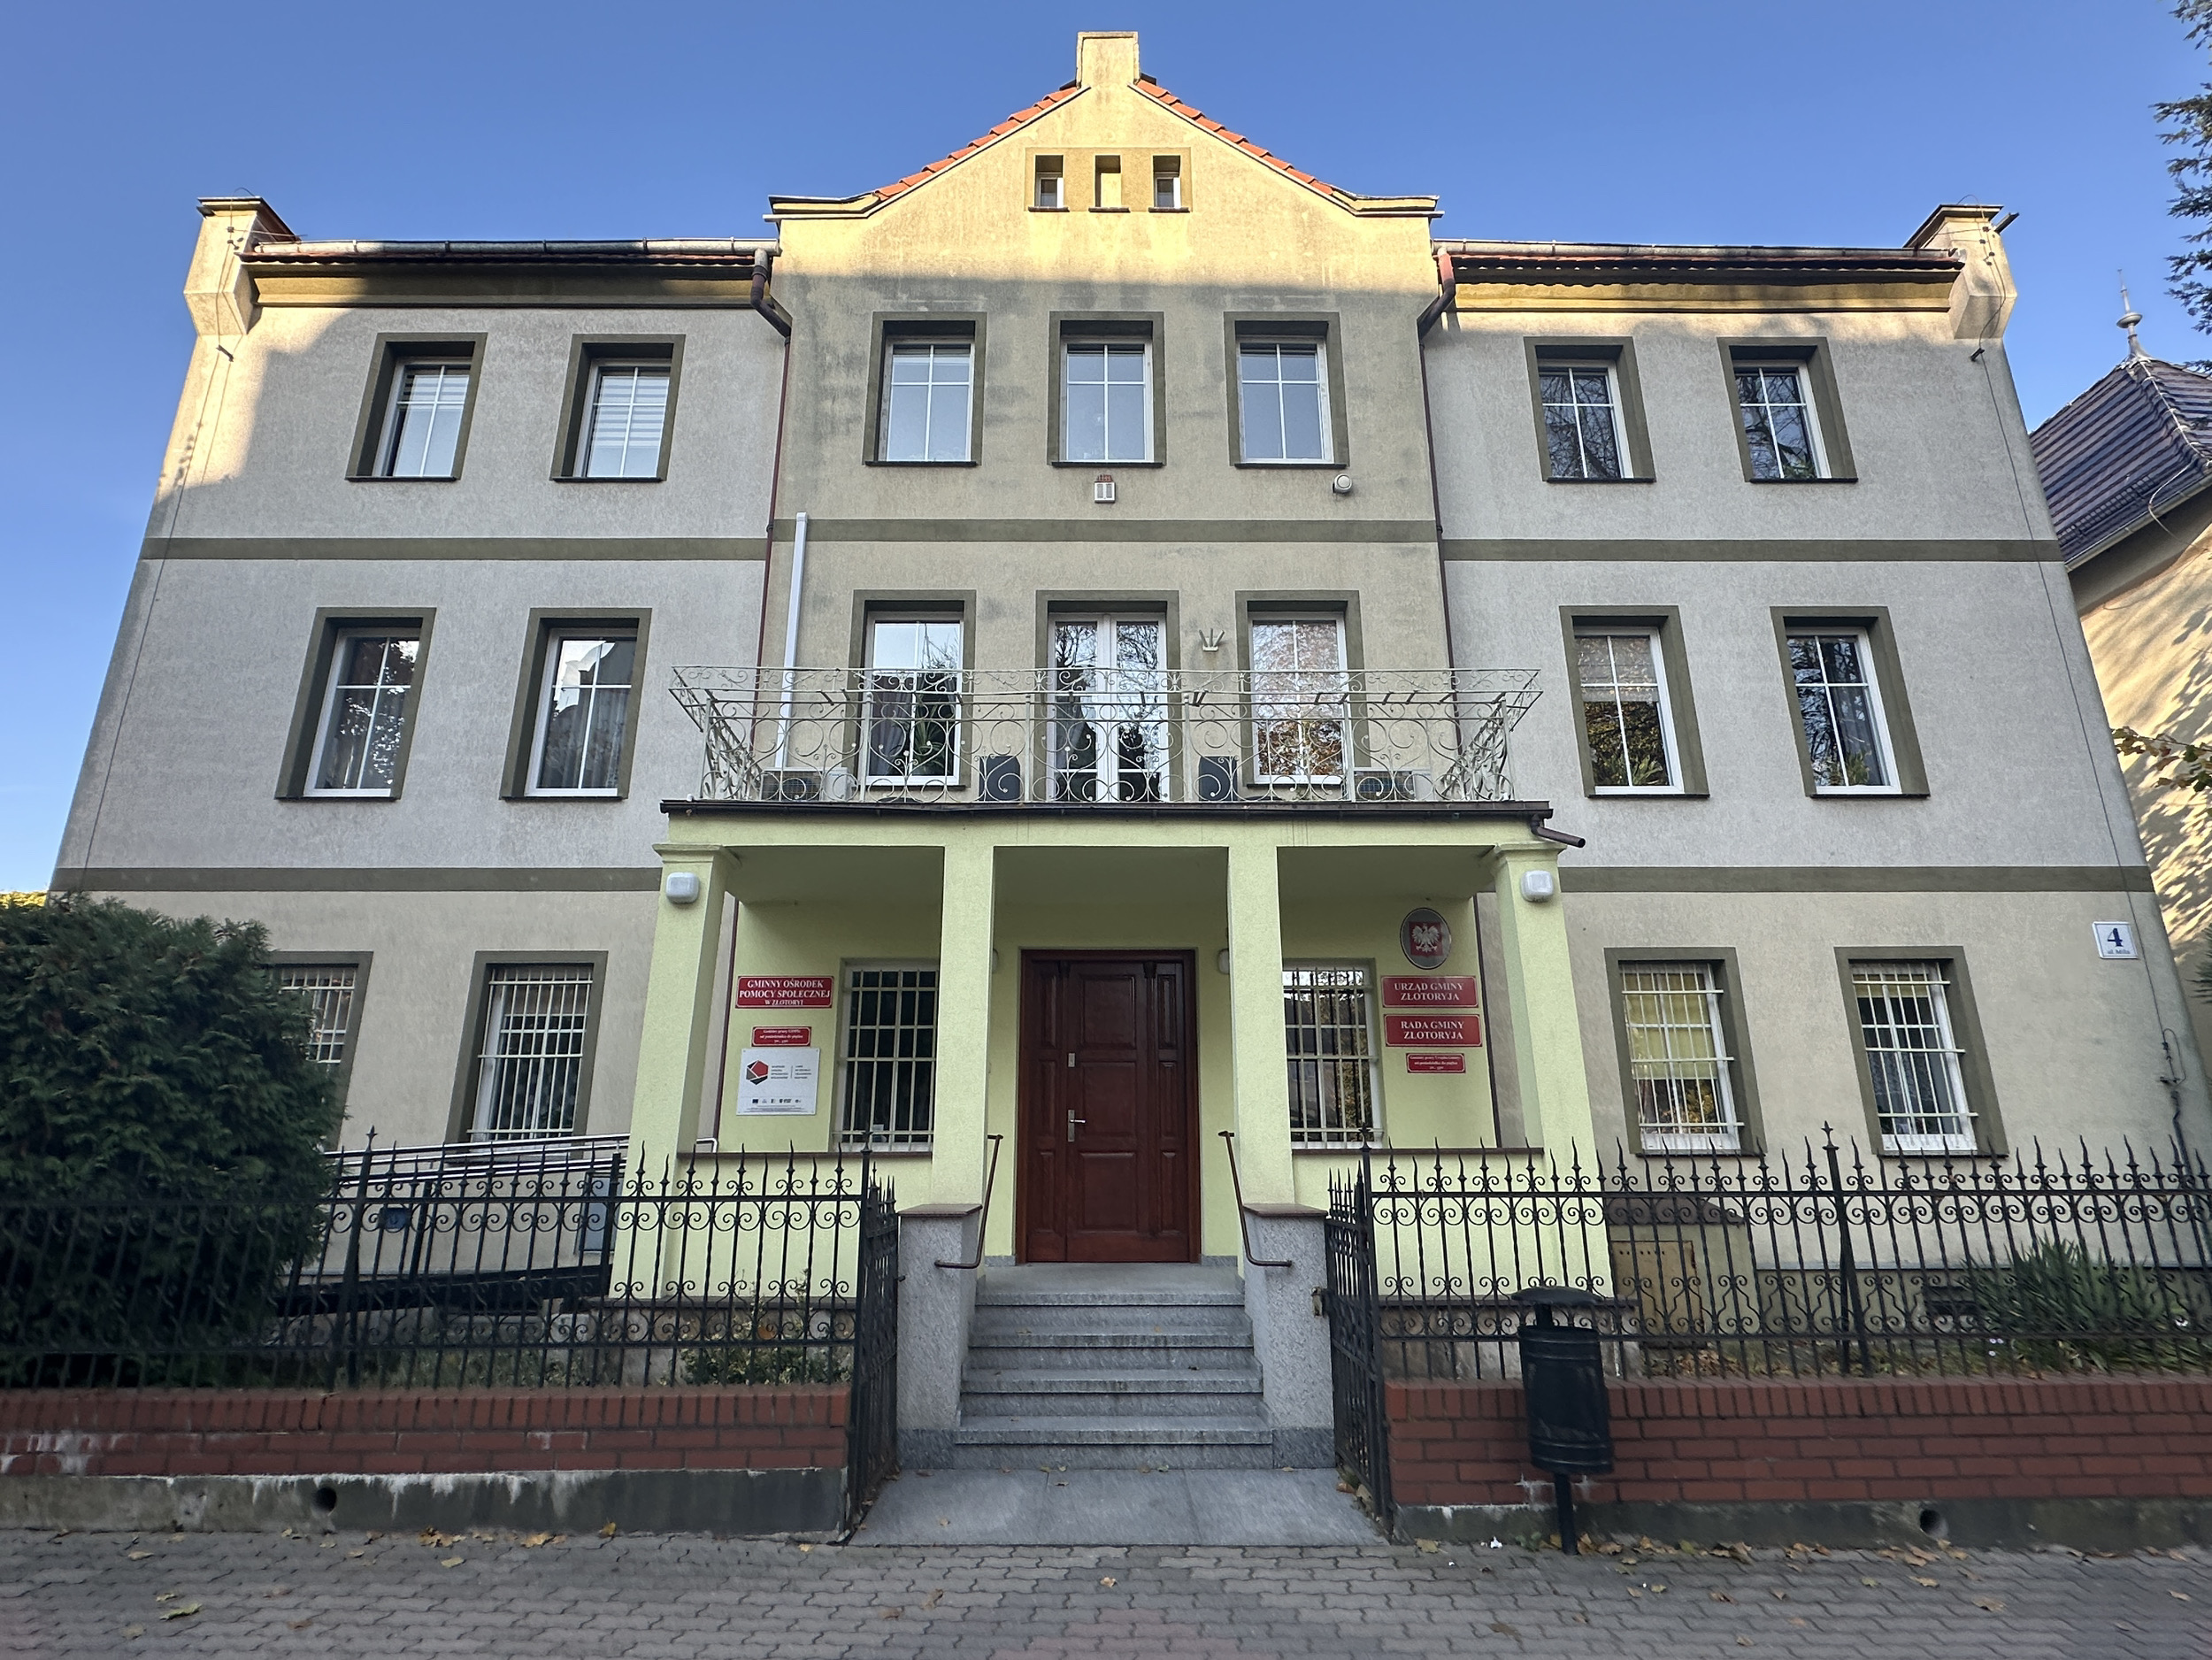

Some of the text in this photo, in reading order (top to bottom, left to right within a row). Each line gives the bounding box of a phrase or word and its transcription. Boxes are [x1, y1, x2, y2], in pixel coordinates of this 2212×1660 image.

[2107, 927, 2124, 947] 4
[747, 978, 824, 988] GMINNY OŚRODEK
[1394, 982, 1428, 992] URZĄD
[739, 989, 776, 998] POMOCY
[1401, 1020, 1464, 1029] RADA GMINY
